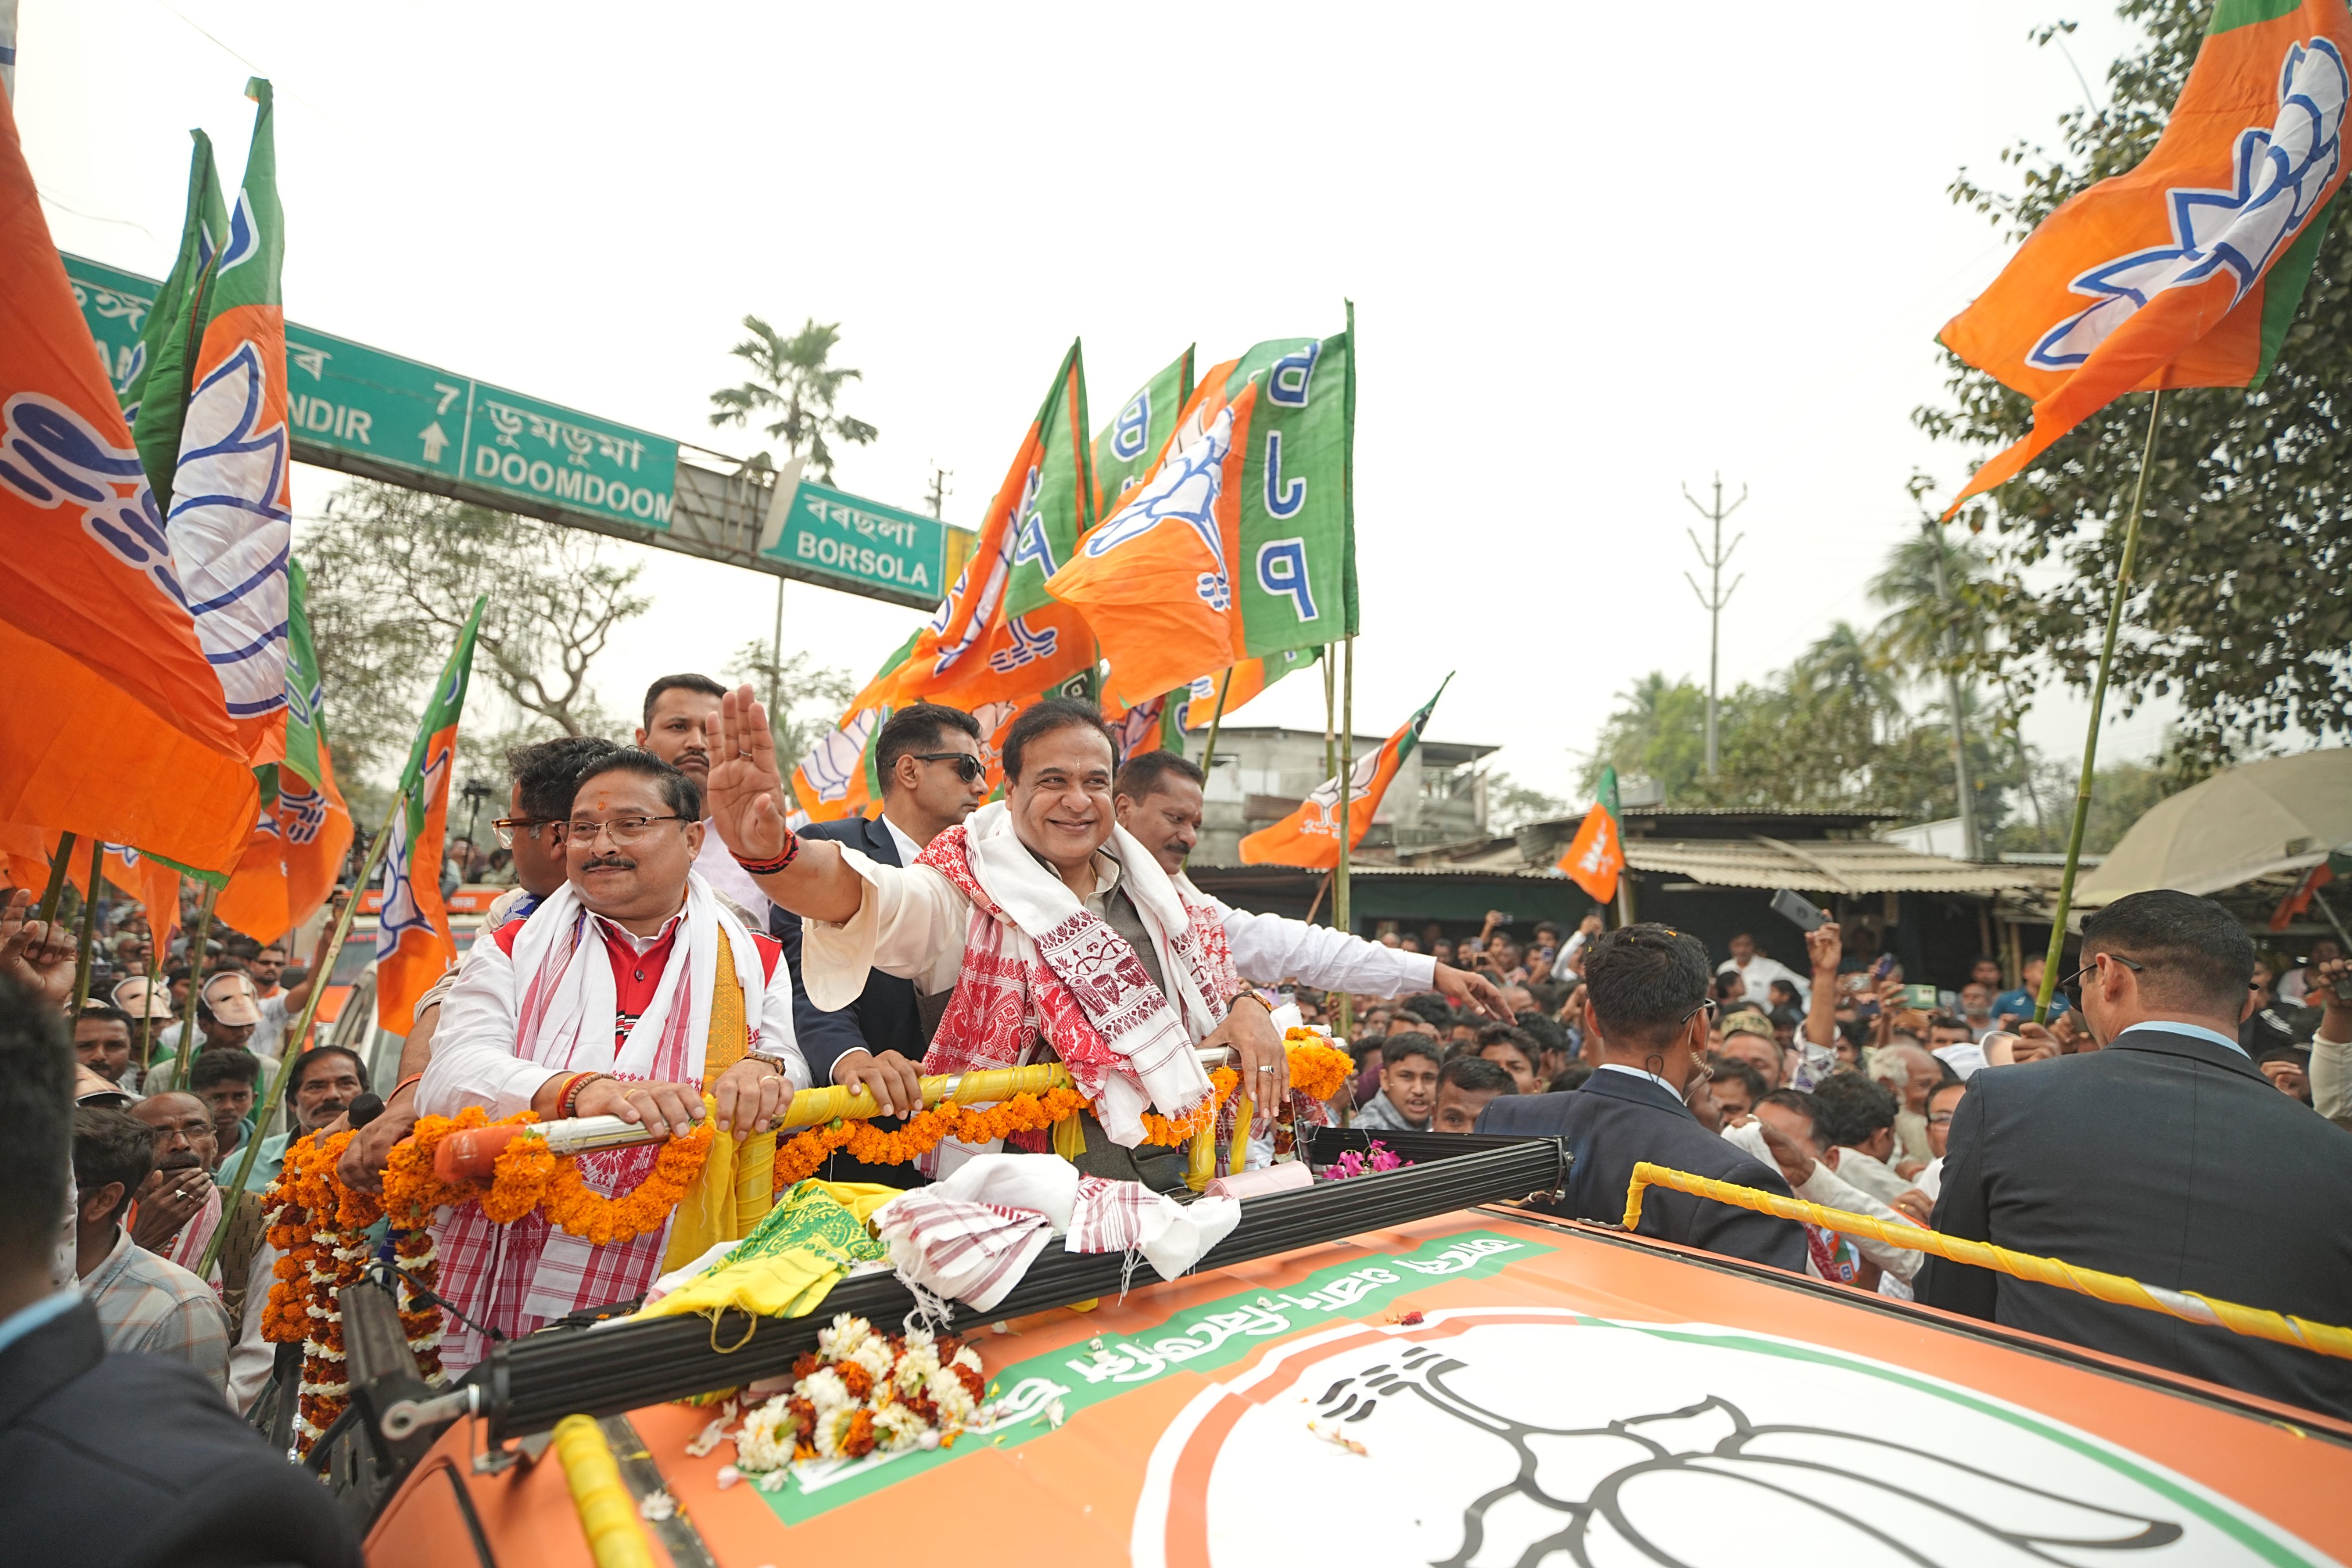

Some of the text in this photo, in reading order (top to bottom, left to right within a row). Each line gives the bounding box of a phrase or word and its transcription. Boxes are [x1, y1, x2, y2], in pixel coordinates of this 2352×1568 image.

[287, 390, 373, 446] NDIR
[434, 381, 461, 416] 7
[484, 398, 647, 473] ডুমডুমা
[796, 529, 930, 589] BORSOLA
